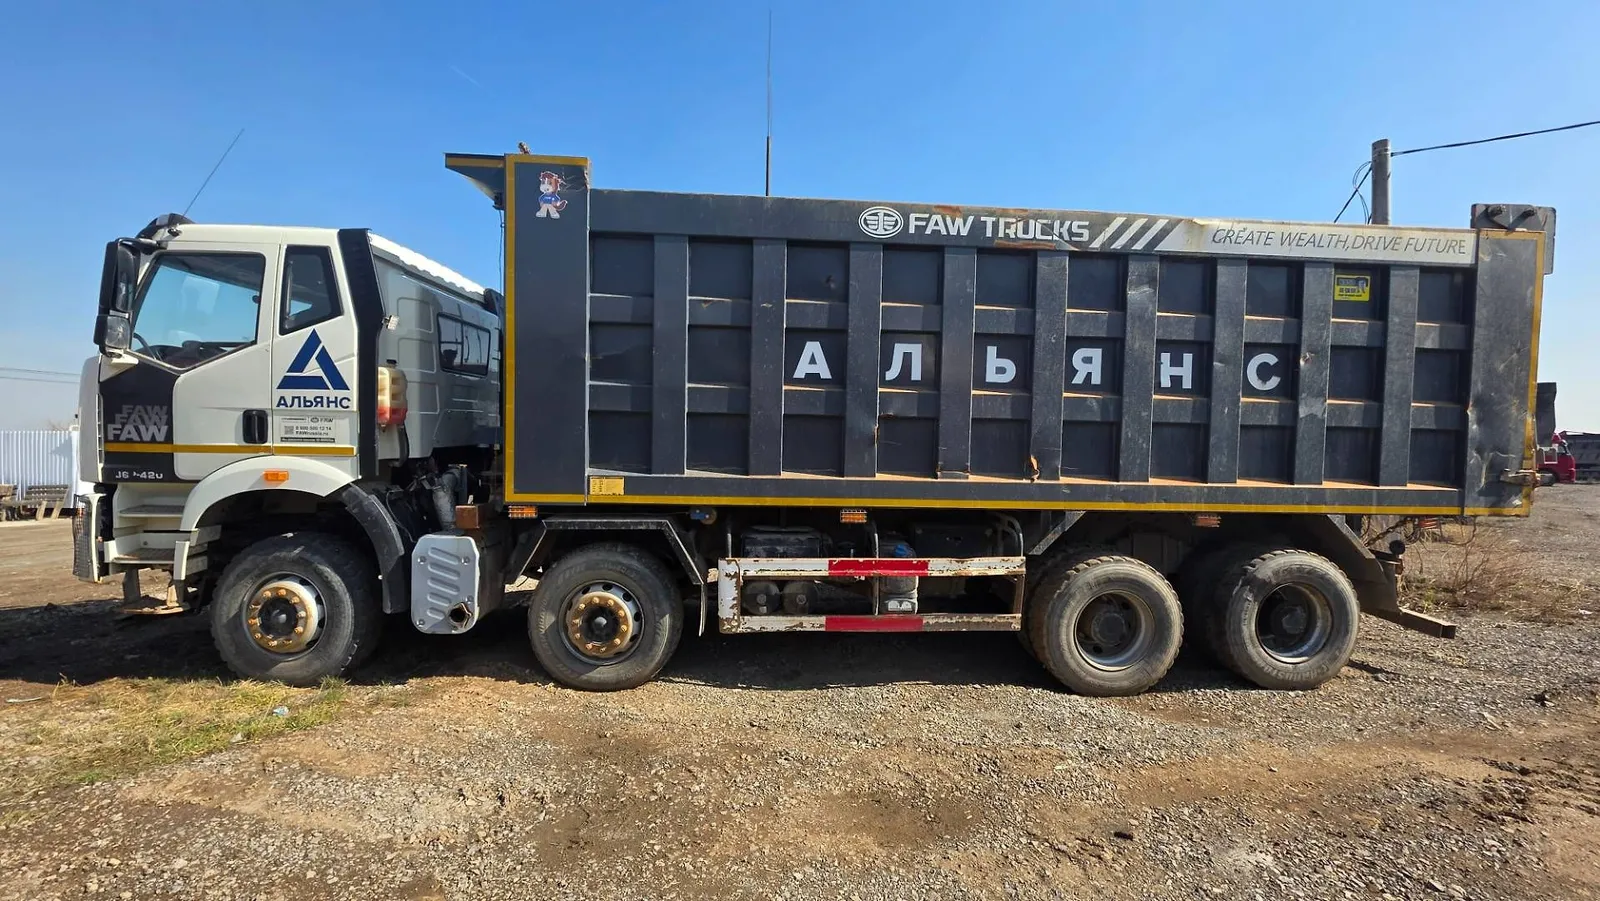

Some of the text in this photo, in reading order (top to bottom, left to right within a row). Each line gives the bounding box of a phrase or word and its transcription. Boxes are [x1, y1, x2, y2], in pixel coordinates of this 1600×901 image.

[908, 213, 1090, 242] FAW TRUCKS
[1211, 228, 1276, 246] CREATE
[1402, 237, 1467, 255] FUTURE
[275, 395, 352, 409] АЛЬЯНС
[122, 404, 168, 418] FAW
[114, 413, 168, 428] FAW
[107, 423, 169, 442] FAW
